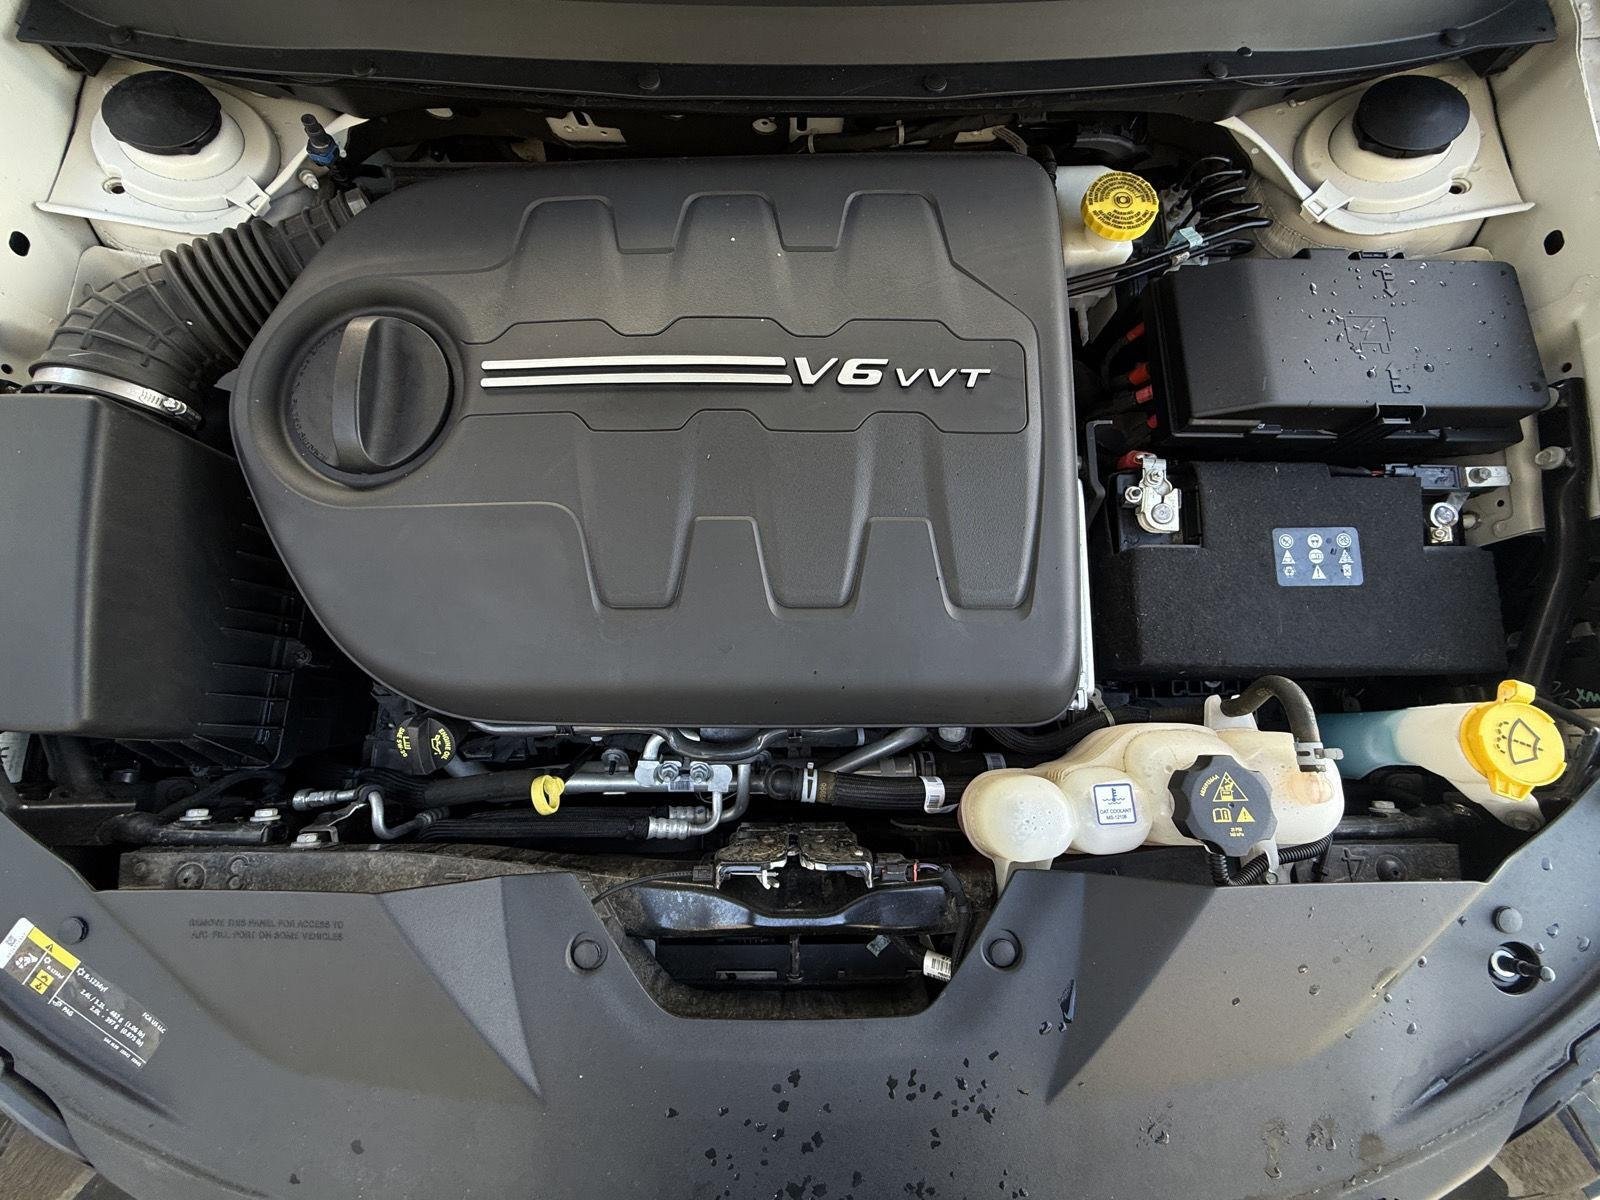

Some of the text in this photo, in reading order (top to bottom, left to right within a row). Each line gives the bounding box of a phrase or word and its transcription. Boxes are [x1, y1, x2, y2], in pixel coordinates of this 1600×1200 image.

[794, 356, 991, 388] V6 VVT
[439, 728, 451, 760] ENGINE OIL
[189, 919, 344, 929] REMOVE THIS PANEL FOR ACCESS TO
[232, 931, 255, 939] PORT
[259, 931, 272, 940] ON
[274, 931, 298, 940] SOME
[302, 932, 343, 941] VEHICLES
[83, 973, 108, 992] R-1234yf
[62, 1006, 74, 1016] PAG
[142, 1012, 152, 1022] FCA
[157, 1025, 166, 1034] LLC
[137, 1030, 146, 1038] lb)
[135, 1038, 144, 1047] lb)
